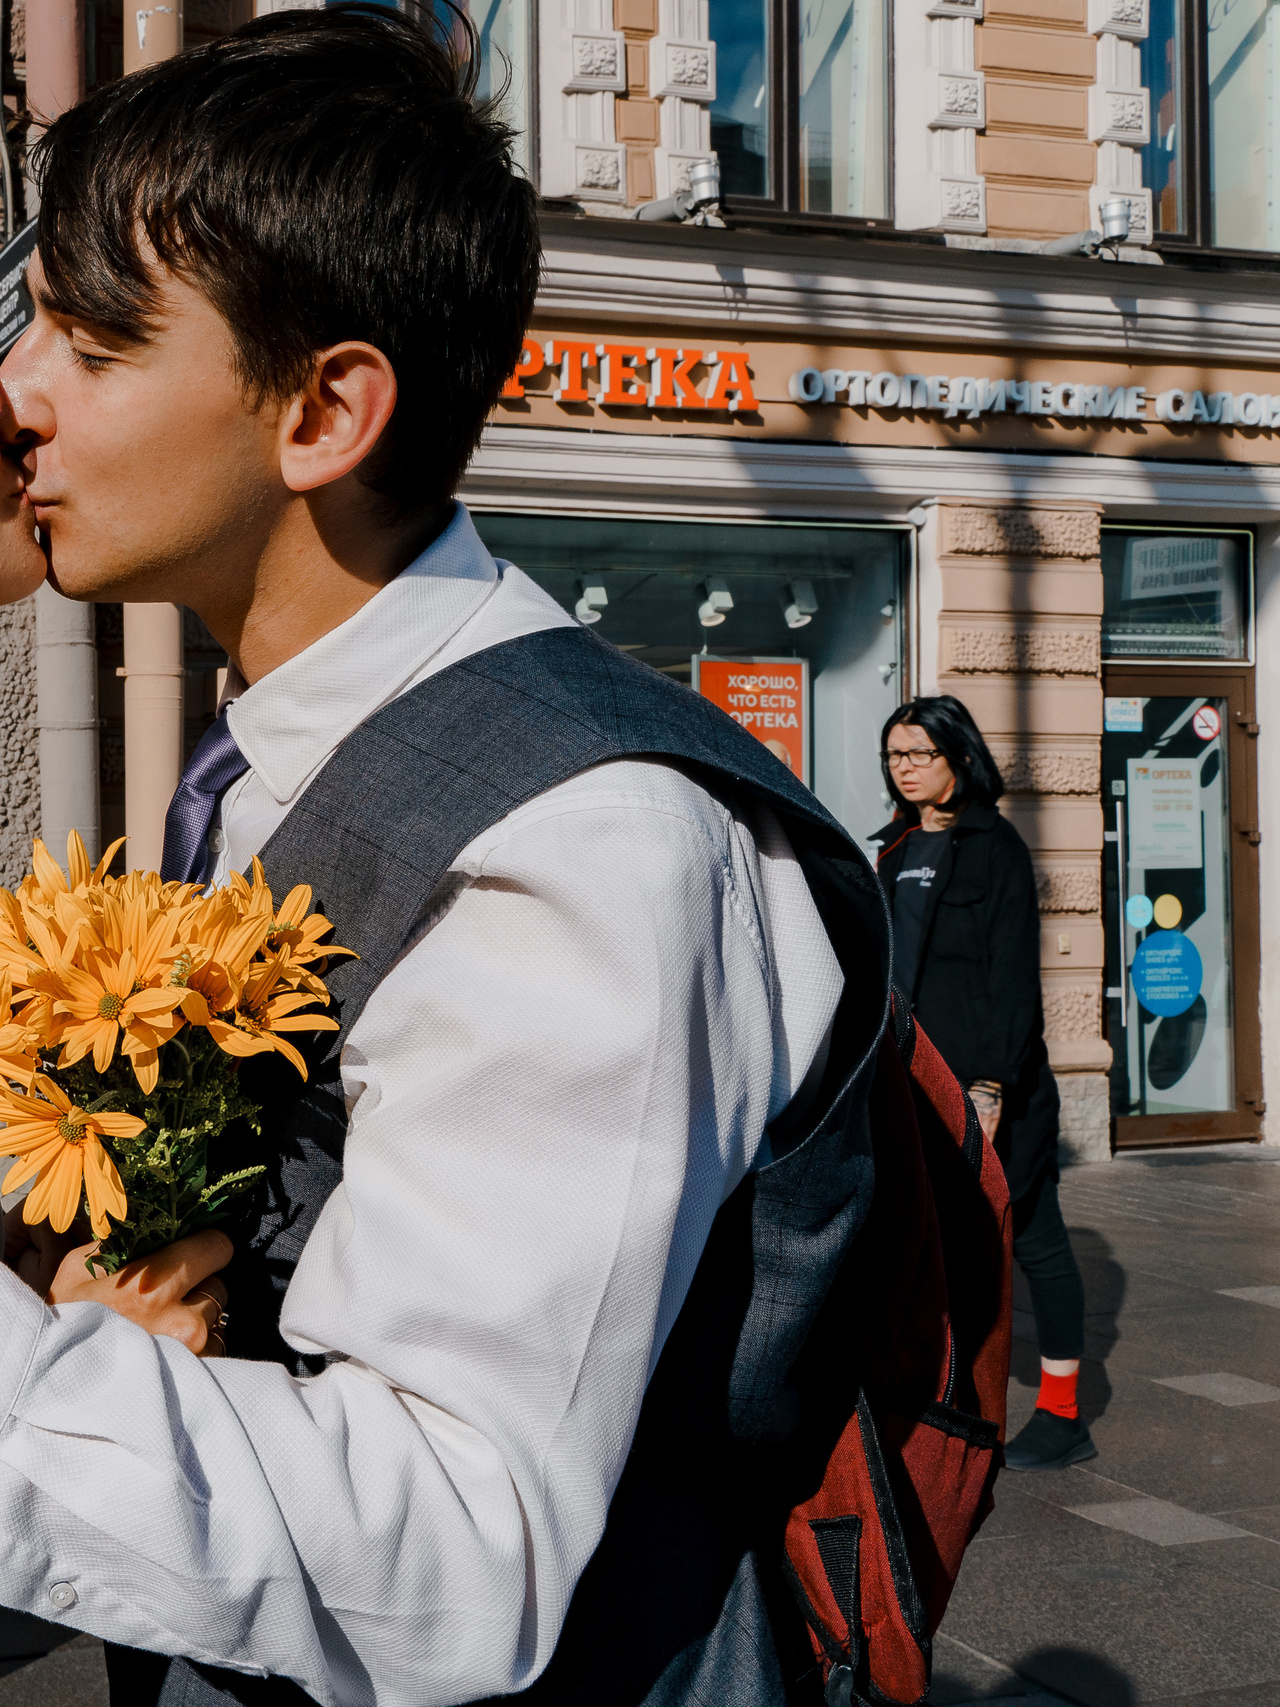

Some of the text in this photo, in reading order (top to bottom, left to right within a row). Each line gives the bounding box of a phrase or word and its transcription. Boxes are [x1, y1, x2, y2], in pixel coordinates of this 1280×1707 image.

[789, 367, 1147, 420] ОРТОПЕДИЧЕСКИЕ
[727, 674, 799, 691] ХОРОШО,
[727, 694, 796, 708] ЧТО ЕСТЬ
